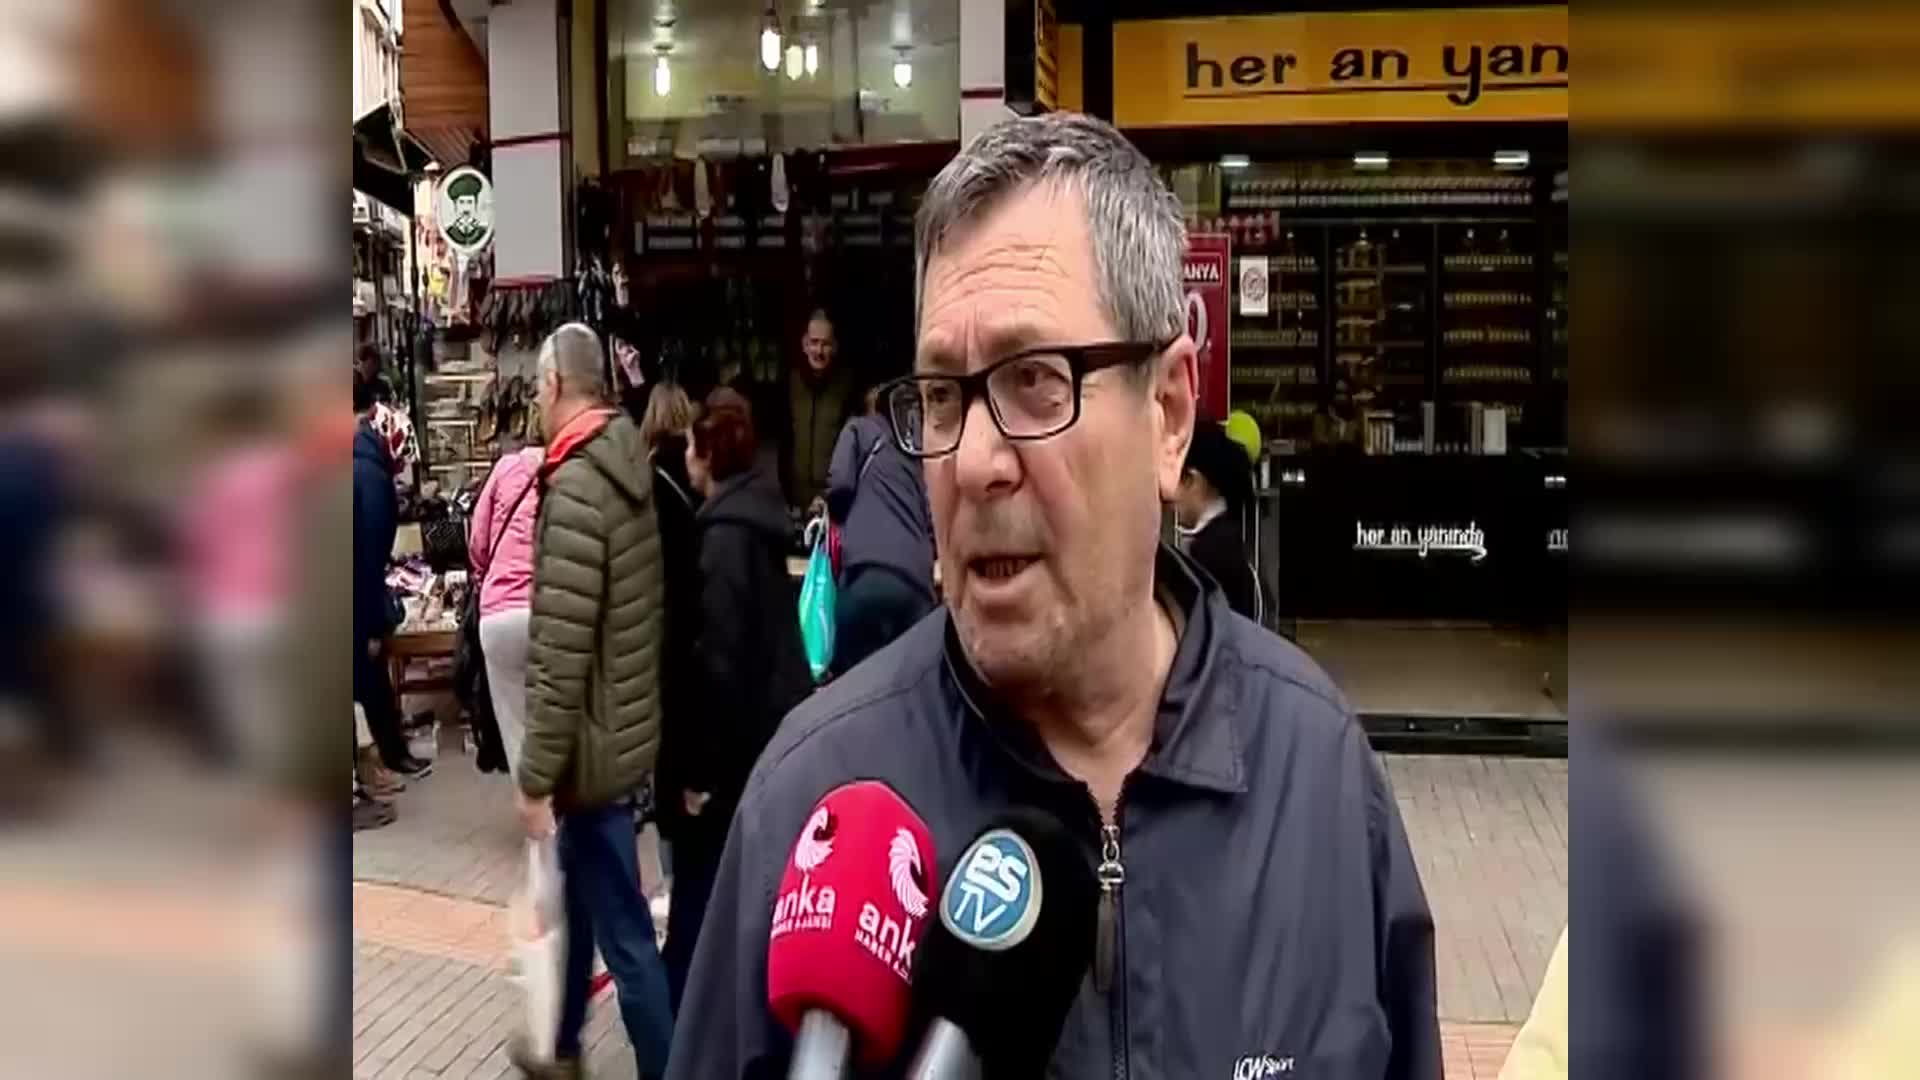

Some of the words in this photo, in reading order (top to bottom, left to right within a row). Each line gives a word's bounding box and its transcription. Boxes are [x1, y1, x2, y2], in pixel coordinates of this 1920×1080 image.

[1185, 41, 1297, 89] her
[1329, 48, 1410, 82] an
[1442, 42, 1568, 106] yan
[1356, 519, 1385, 546] her
[1391, 526, 1412, 546] an
[772, 874, 836, 923] anka
[954, 881, 1007, 933] TV
